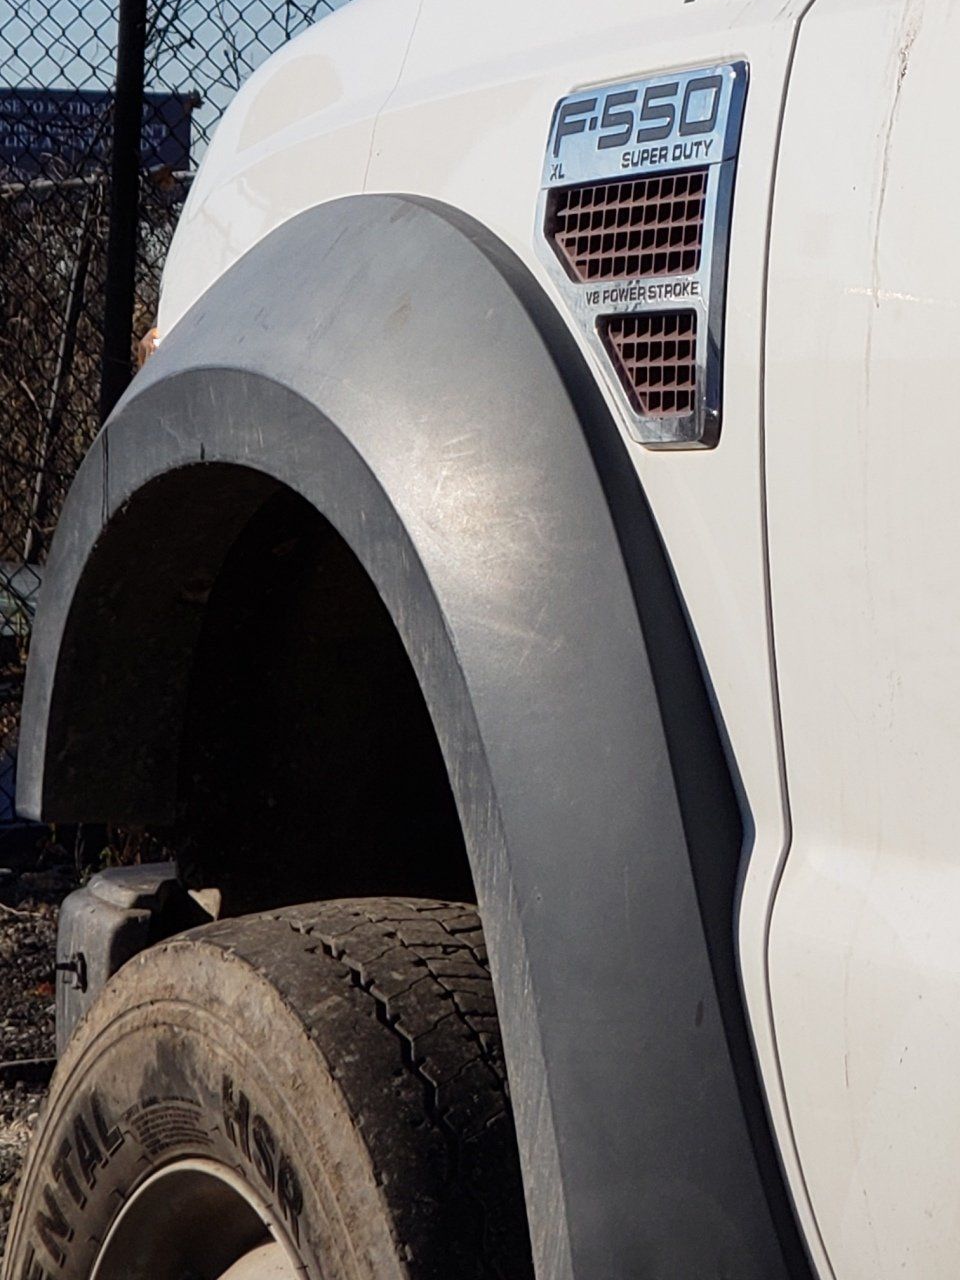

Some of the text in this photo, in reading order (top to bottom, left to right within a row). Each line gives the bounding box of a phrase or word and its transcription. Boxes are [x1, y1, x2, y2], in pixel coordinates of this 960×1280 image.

[621, 139, 713, 169] SUPER DUTY
[550, 164, 565, 181] XL
[586, 291, 600, 305] V8
